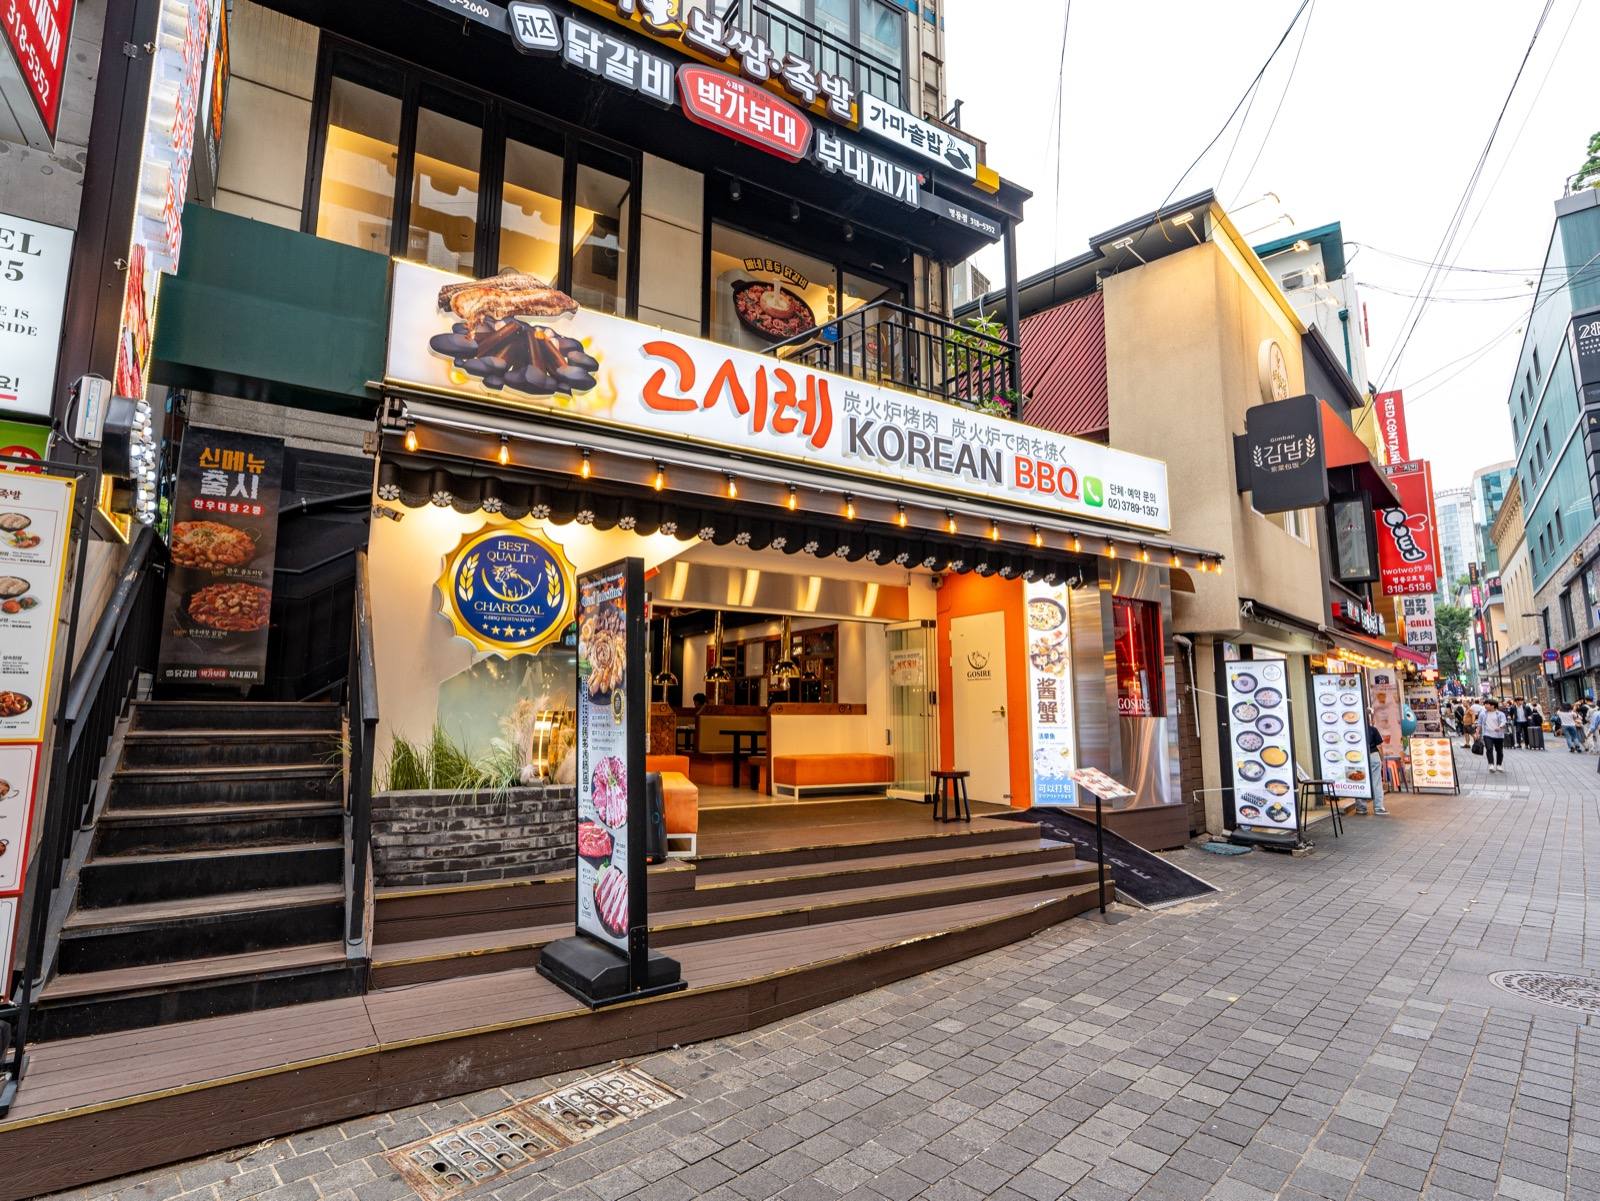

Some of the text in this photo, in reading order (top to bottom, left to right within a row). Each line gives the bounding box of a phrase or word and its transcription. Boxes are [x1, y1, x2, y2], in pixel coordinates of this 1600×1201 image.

[448, 0, 490, 18] -2000
[517, 14, 557, 40] 치즈
[567, 21, 671, 99] 닭갈비
[698, 77, 796, 146] 박가부대
[868, 104, 943, 148] 가마솥밥
[818, 132, 918, 204] 부대찌개
[14, 308, 30, 320] IS
[642, 340, 833, 449] 고시레
[843, 390, 939, 434] 炭火炉烤肉
[1384, 397, 1396, 418] RED
[952, 418, 1069, 465] 炭火炉で肉を焼く
[1263, 440, 1304, 465] 김밥
[200, 447, 265, 474] 신메뉴
[848, 416, 1081, 501] KOREAN BBQ
[201, 470, 260, 500] 출시
[1143, 490, 1158, 504] 문의
[1108, 497, 1160, 518] 02)3789-1357
[487, 551, 538, 564] QUALITY
[498, 540, 530, 552] BEST
[1387, 582, 1432, 594] 318-5136
[474, 600, 544, 615] CHARCOAL
[1036, 677, 1058, 724] 酱蟹
[1117, 697, 1151, 711] GOSIRE
[1038, 783, 1072, 793] 可以打包
